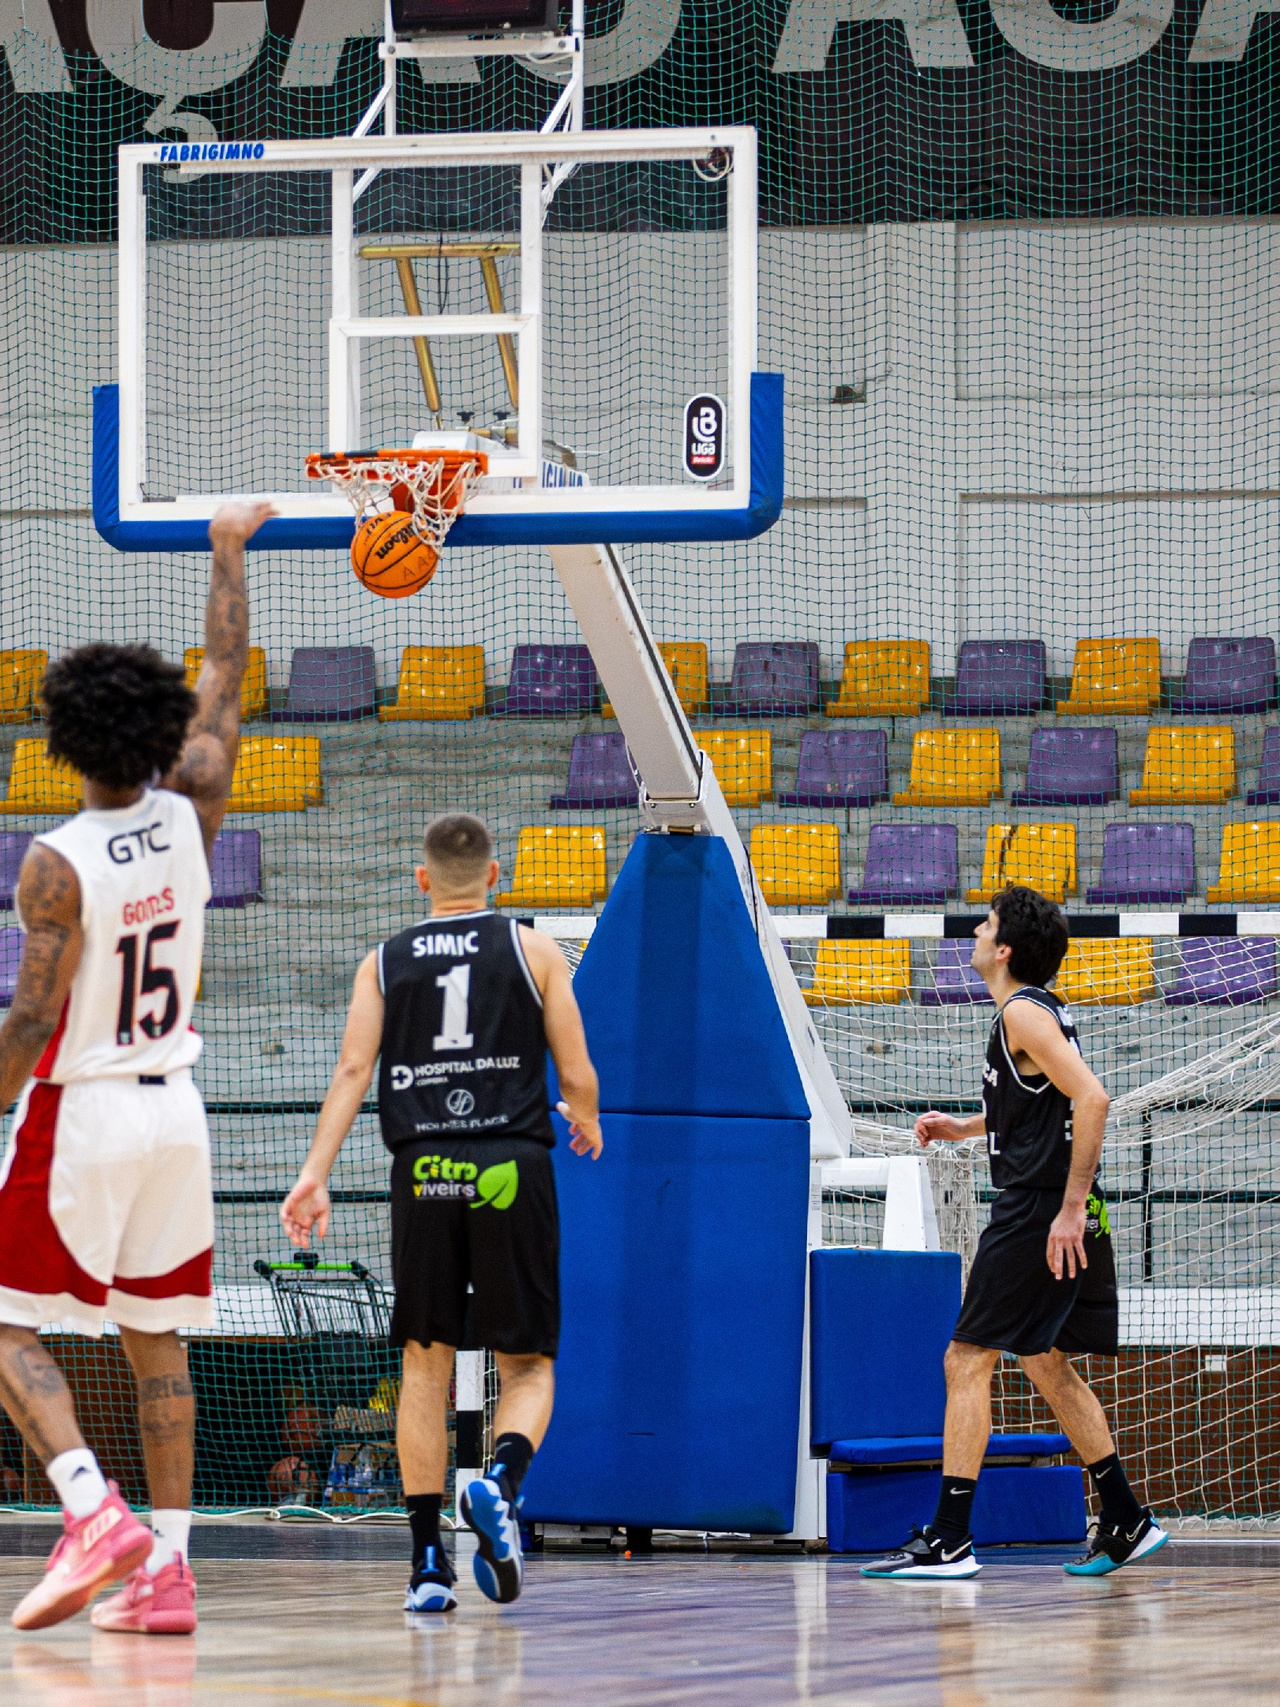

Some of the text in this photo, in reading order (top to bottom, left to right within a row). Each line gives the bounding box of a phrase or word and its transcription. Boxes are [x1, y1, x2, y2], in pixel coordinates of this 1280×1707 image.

[159, 143, 265, 162] FABRIGIMNO
[107, 821, 172, 865] GTC
[412, 930, 479, 958] SIMIC
[115, 920, 182, 1046] 15
[432, 964, 474, 1051] 1
[414, 1056, 520, 1077] HOSPITAL DA LUZ
[469, 1114, 509, 1129] PLACE
[413, 1155, 478, 1180] Citro
